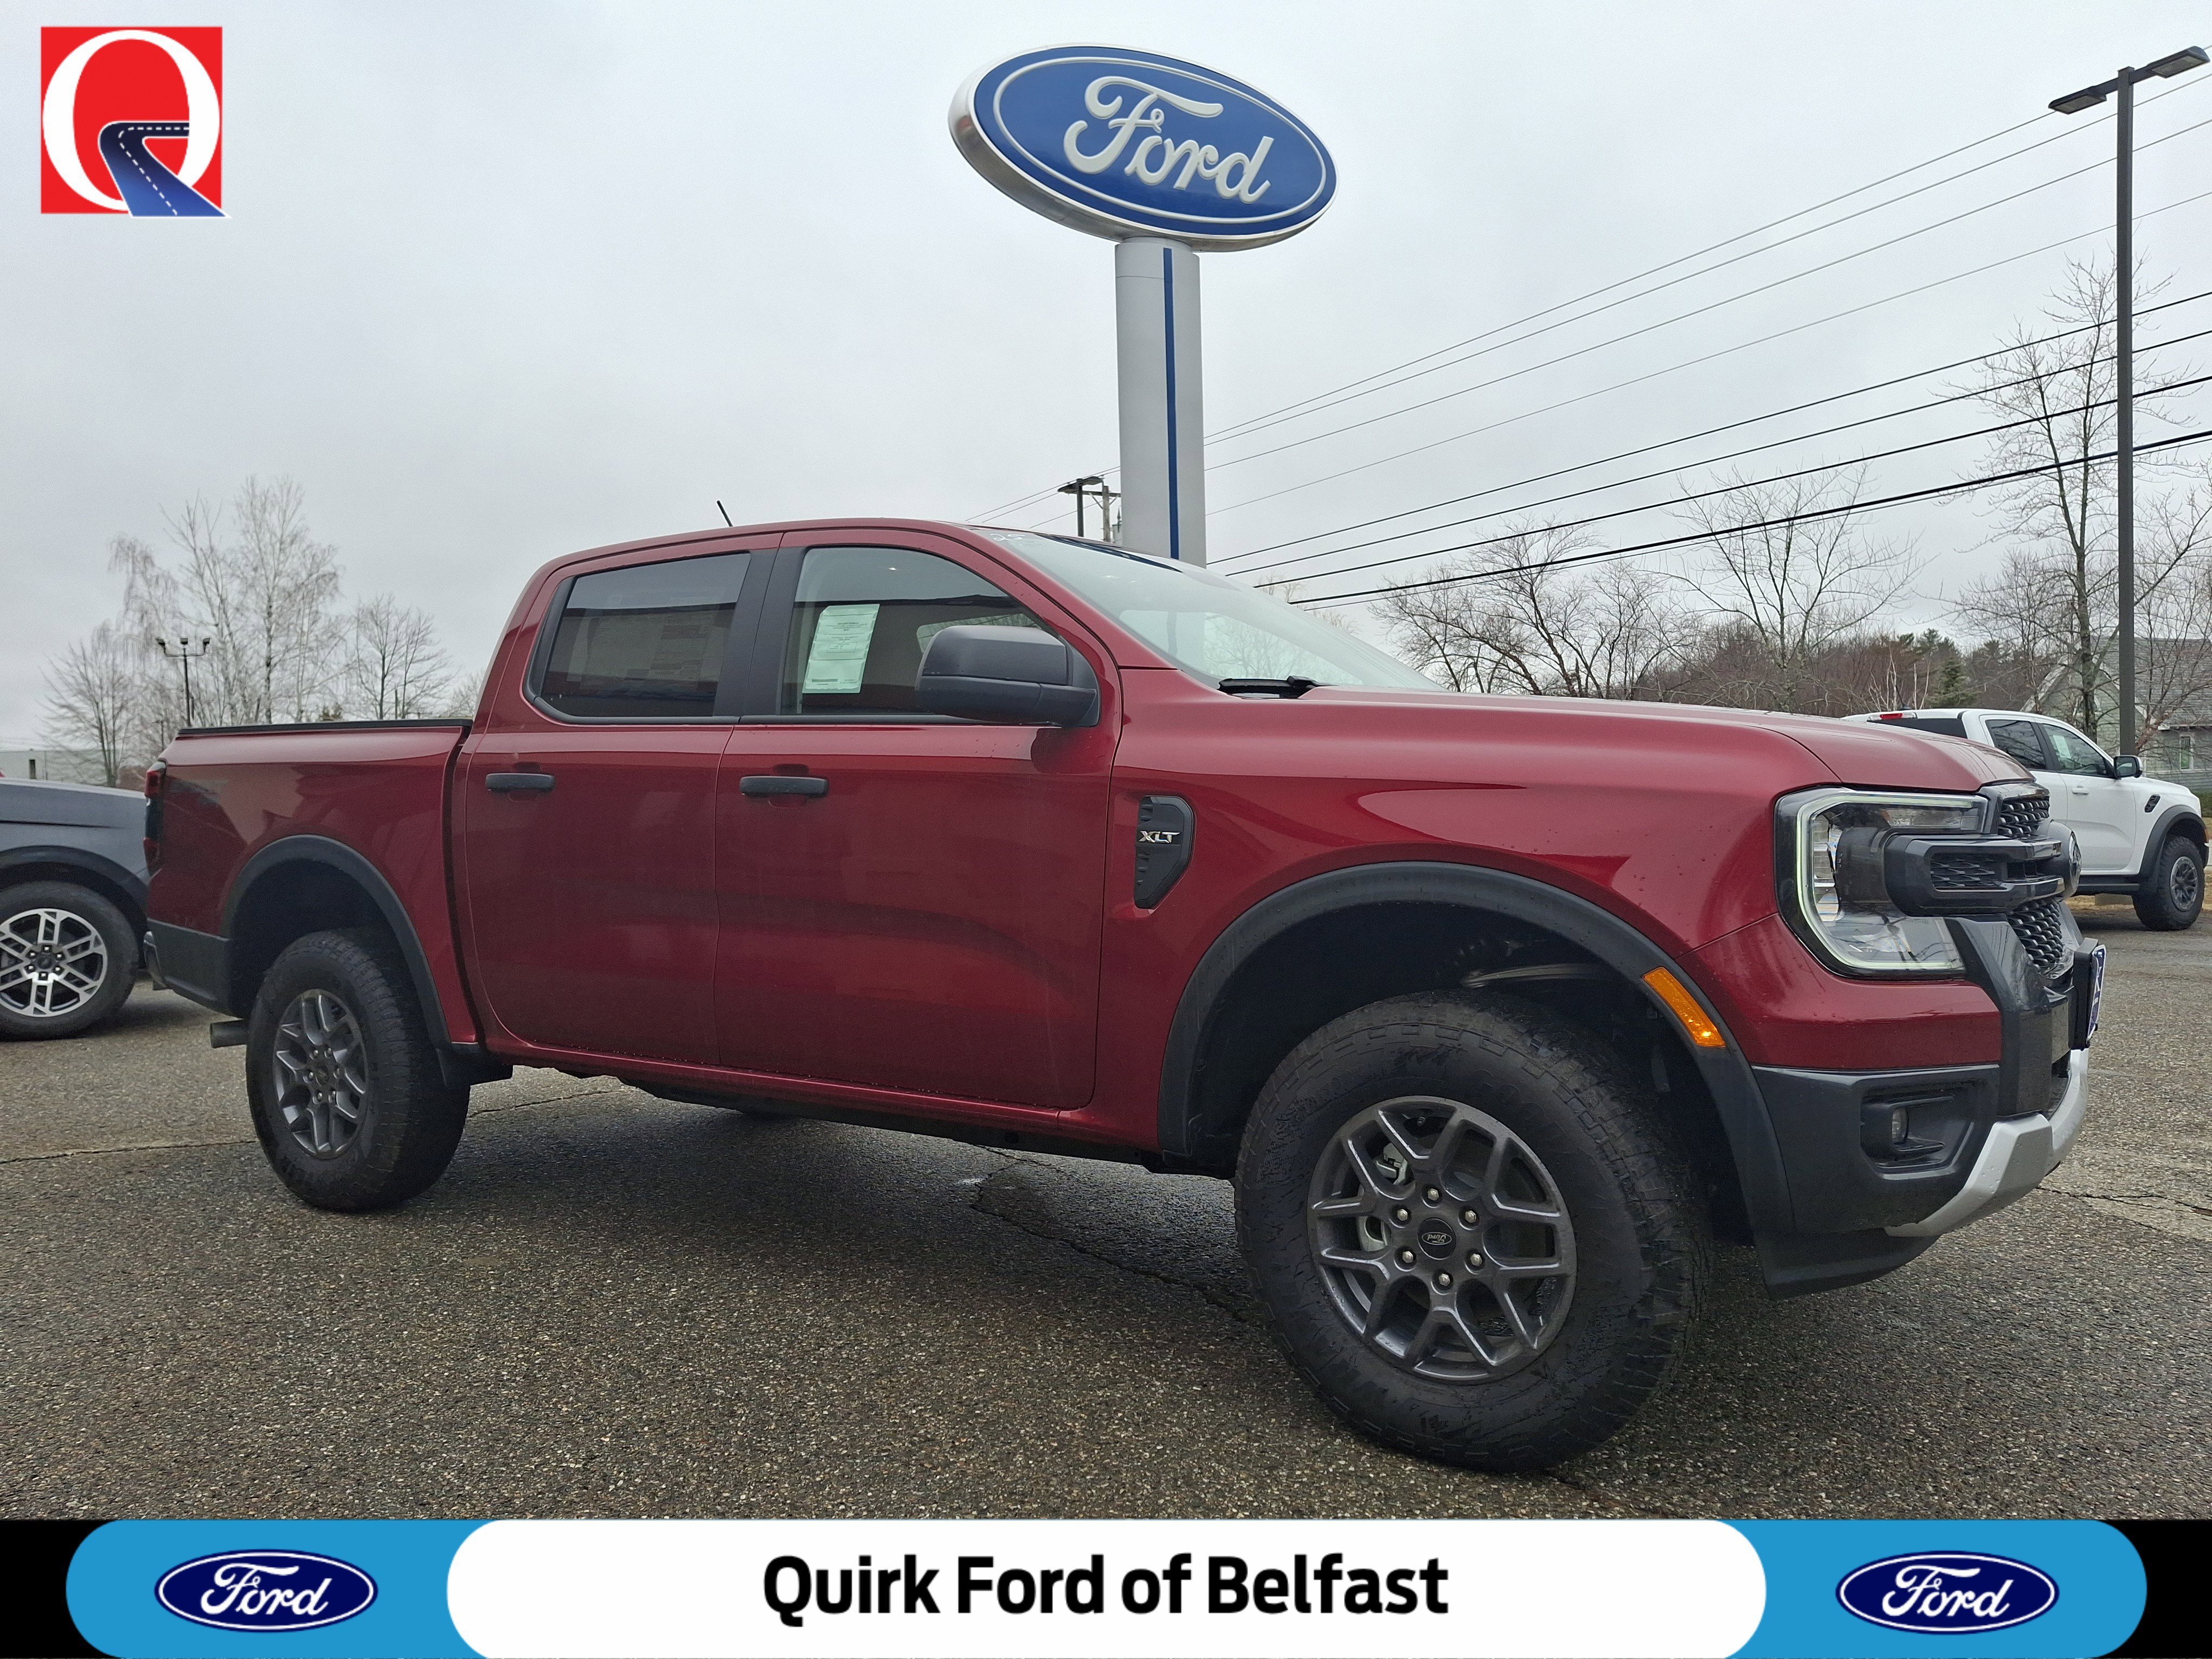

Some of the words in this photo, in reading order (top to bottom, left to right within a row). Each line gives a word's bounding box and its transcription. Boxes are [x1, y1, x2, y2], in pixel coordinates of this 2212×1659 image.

[1063, 76, 1275, 204] Ford
[1139, 831, 1180, 844] XLT
[1426, 1233, 1446, 1244] Ford
